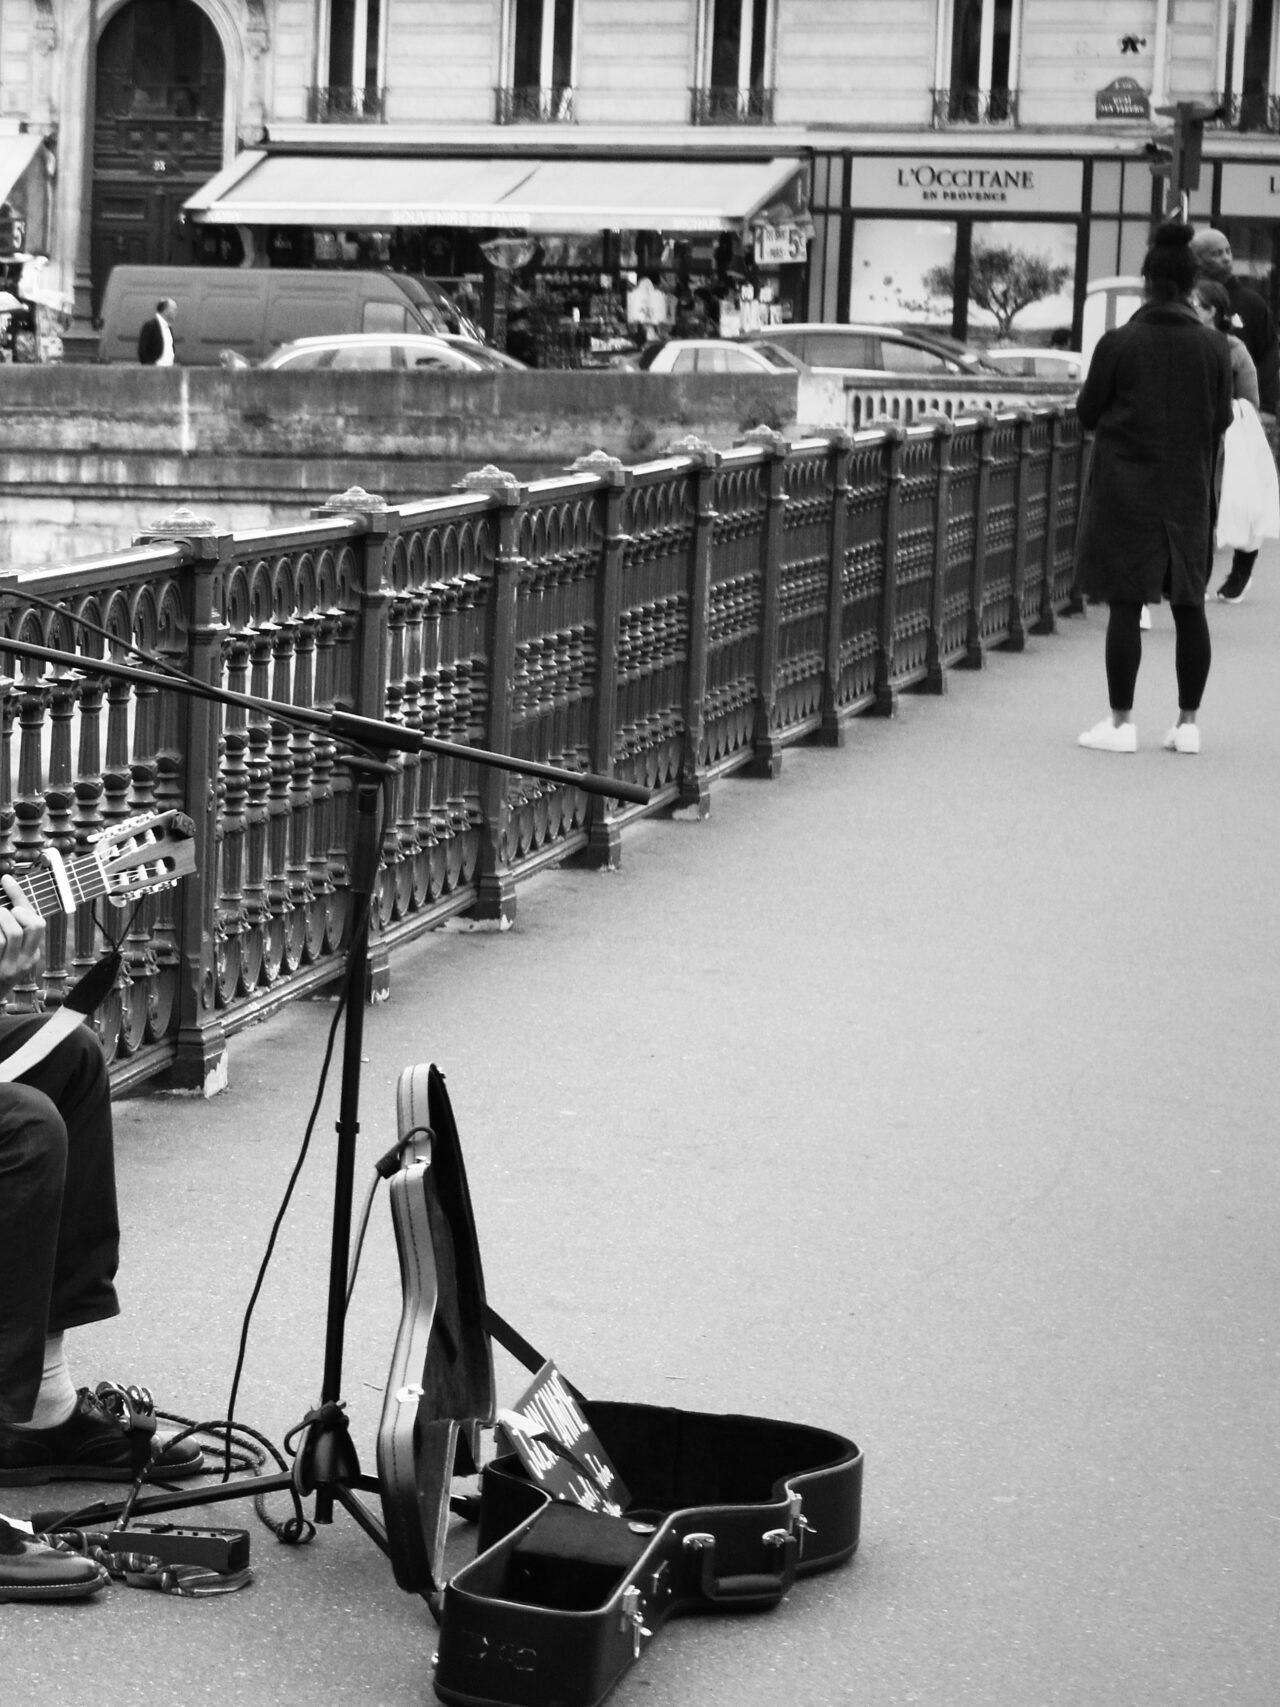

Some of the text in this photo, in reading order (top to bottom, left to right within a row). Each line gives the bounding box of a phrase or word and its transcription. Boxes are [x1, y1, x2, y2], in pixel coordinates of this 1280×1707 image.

[897, 165, 1034, 189] L'OCCITANE
[922, 190, 1007, 202] EN PROVENCE
[391, 211, 467, 225] SOUVENIRS
[491, 213, 531, 227] PARIS
